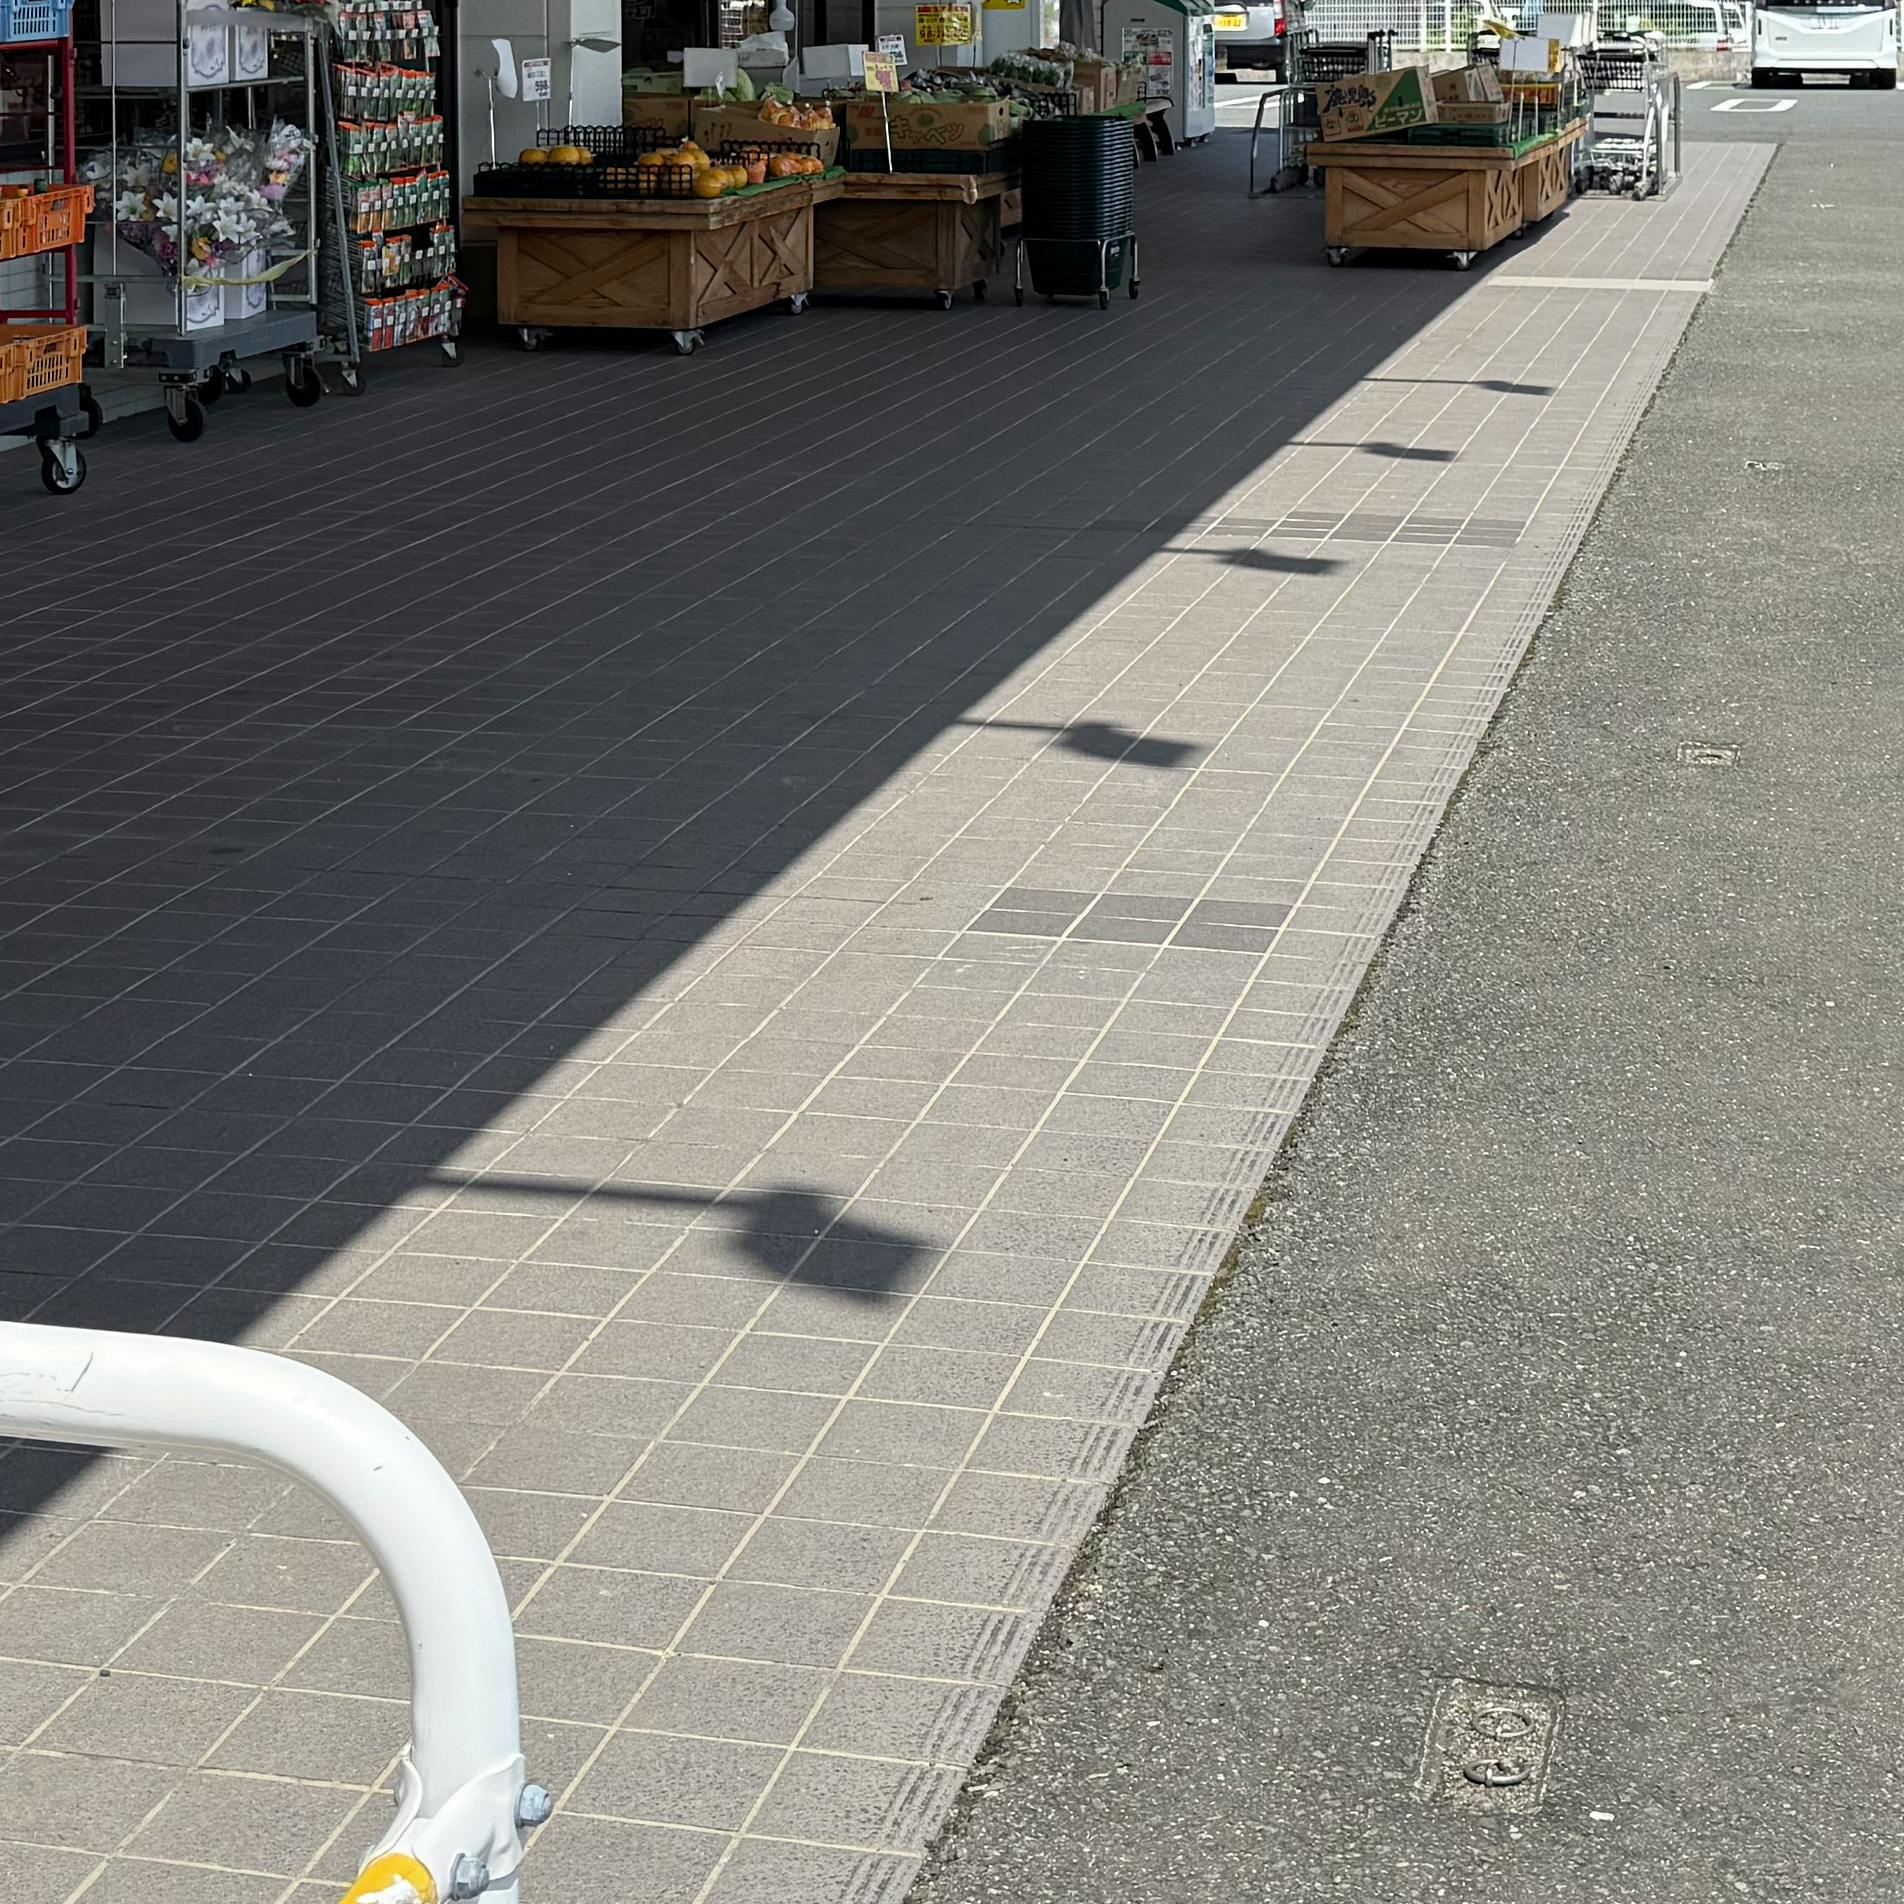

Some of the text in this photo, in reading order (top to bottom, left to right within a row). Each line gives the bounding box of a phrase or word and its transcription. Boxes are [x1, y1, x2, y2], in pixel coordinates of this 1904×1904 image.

[890, 114, 965, 145] キャベツ
[1375, 108, 1423, 129] ピーマン
